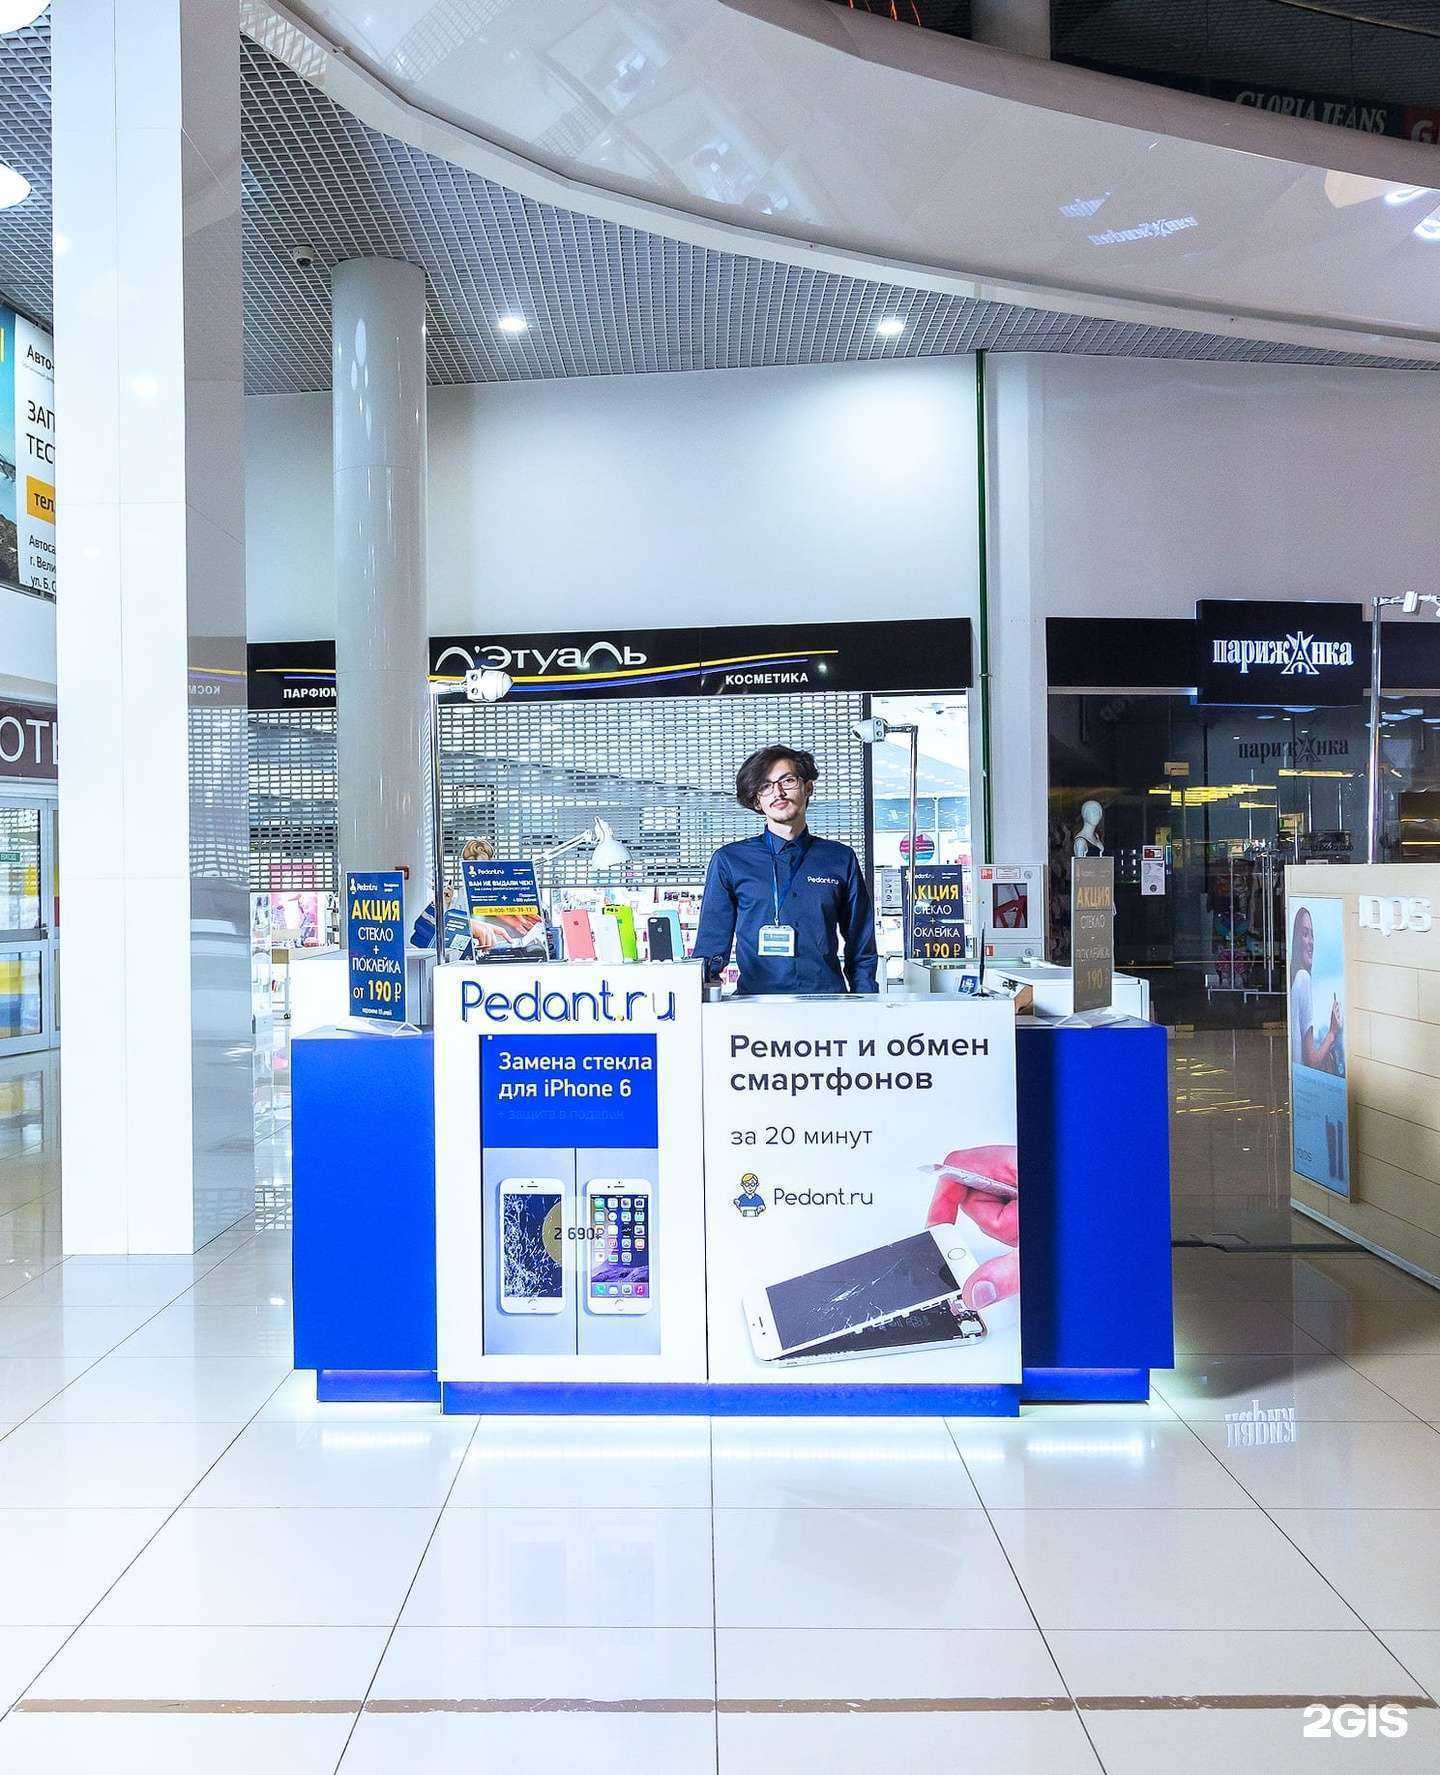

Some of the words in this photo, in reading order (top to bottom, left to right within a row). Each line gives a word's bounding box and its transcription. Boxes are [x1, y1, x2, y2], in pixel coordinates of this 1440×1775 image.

[26, 433, 55, 465] ТЕС
[725, 672, 809, 686] КОСМЕТИКА
[807, 875, 839, 885] Pedant.ru
[351, 899, 400, 923] АКЦИЯ
[358, 926, 394, 941] СТЕКЛО
[913, 925, 960, 938] ОКЛЕЙКА
[924, 942, 950, 958] 190
[352, 956, 402, 974] ПОКЛЕЙКА
[353, 986, 364, 999] от
[368, 979, 392, 1002] 190
[461, 979, 676, 1022] Pedant.ru
[730, 1034, 848, 1058] Ремонт
[858, 1038, 876, 1057] и
[887, 1032, 989, 1057] обмен
[498, 1051, 576, 1070] Замена
[582, 1054, 653, 1070] стекла
[498, 1082, 537, 1099] для
[544, 1078, 613, 1097] iPhone
[619, 1078, 632, 1097] 6
[730, 1066, 933, 1097] смартфонов
[730, 1131, 757, 1146] за
[765, 1126, 796, 1146] 20
[804, 1130, 873, 1150] минут
[773, 1187, 873, 1206] Pedant.ru
